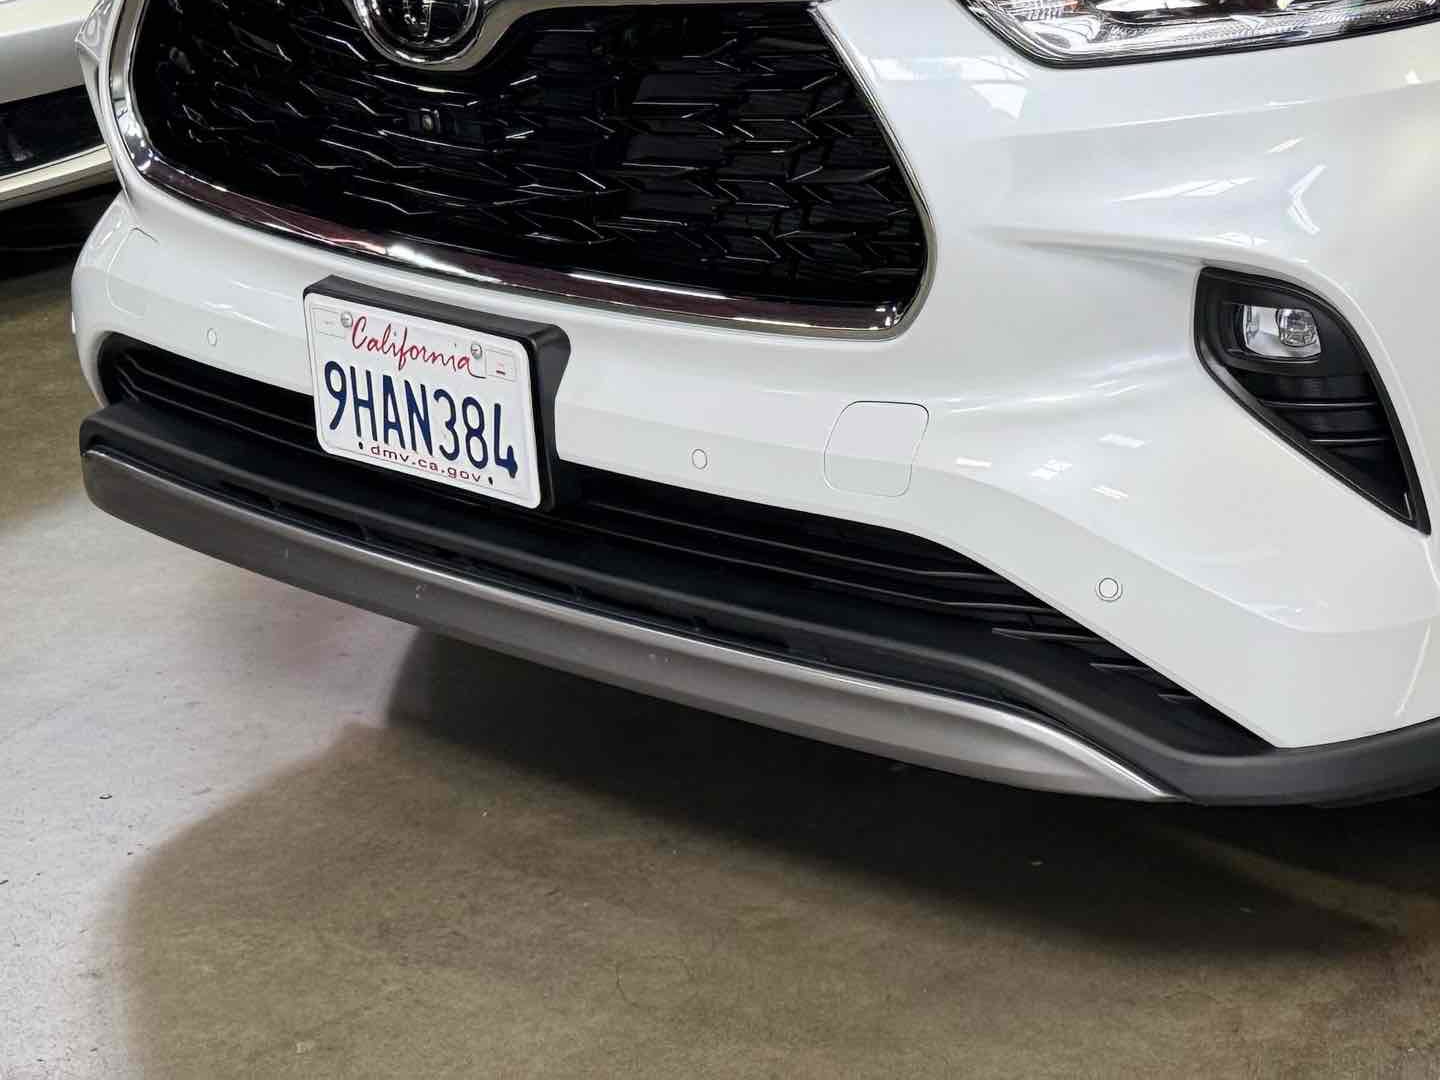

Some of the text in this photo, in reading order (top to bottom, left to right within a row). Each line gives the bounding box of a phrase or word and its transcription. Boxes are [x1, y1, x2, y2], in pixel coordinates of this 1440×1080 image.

[351, 315, 486, 379] California
[323, 360, 518, 479] 9HAN384
[370, 444, 482, 481] dmv.ca.gov
